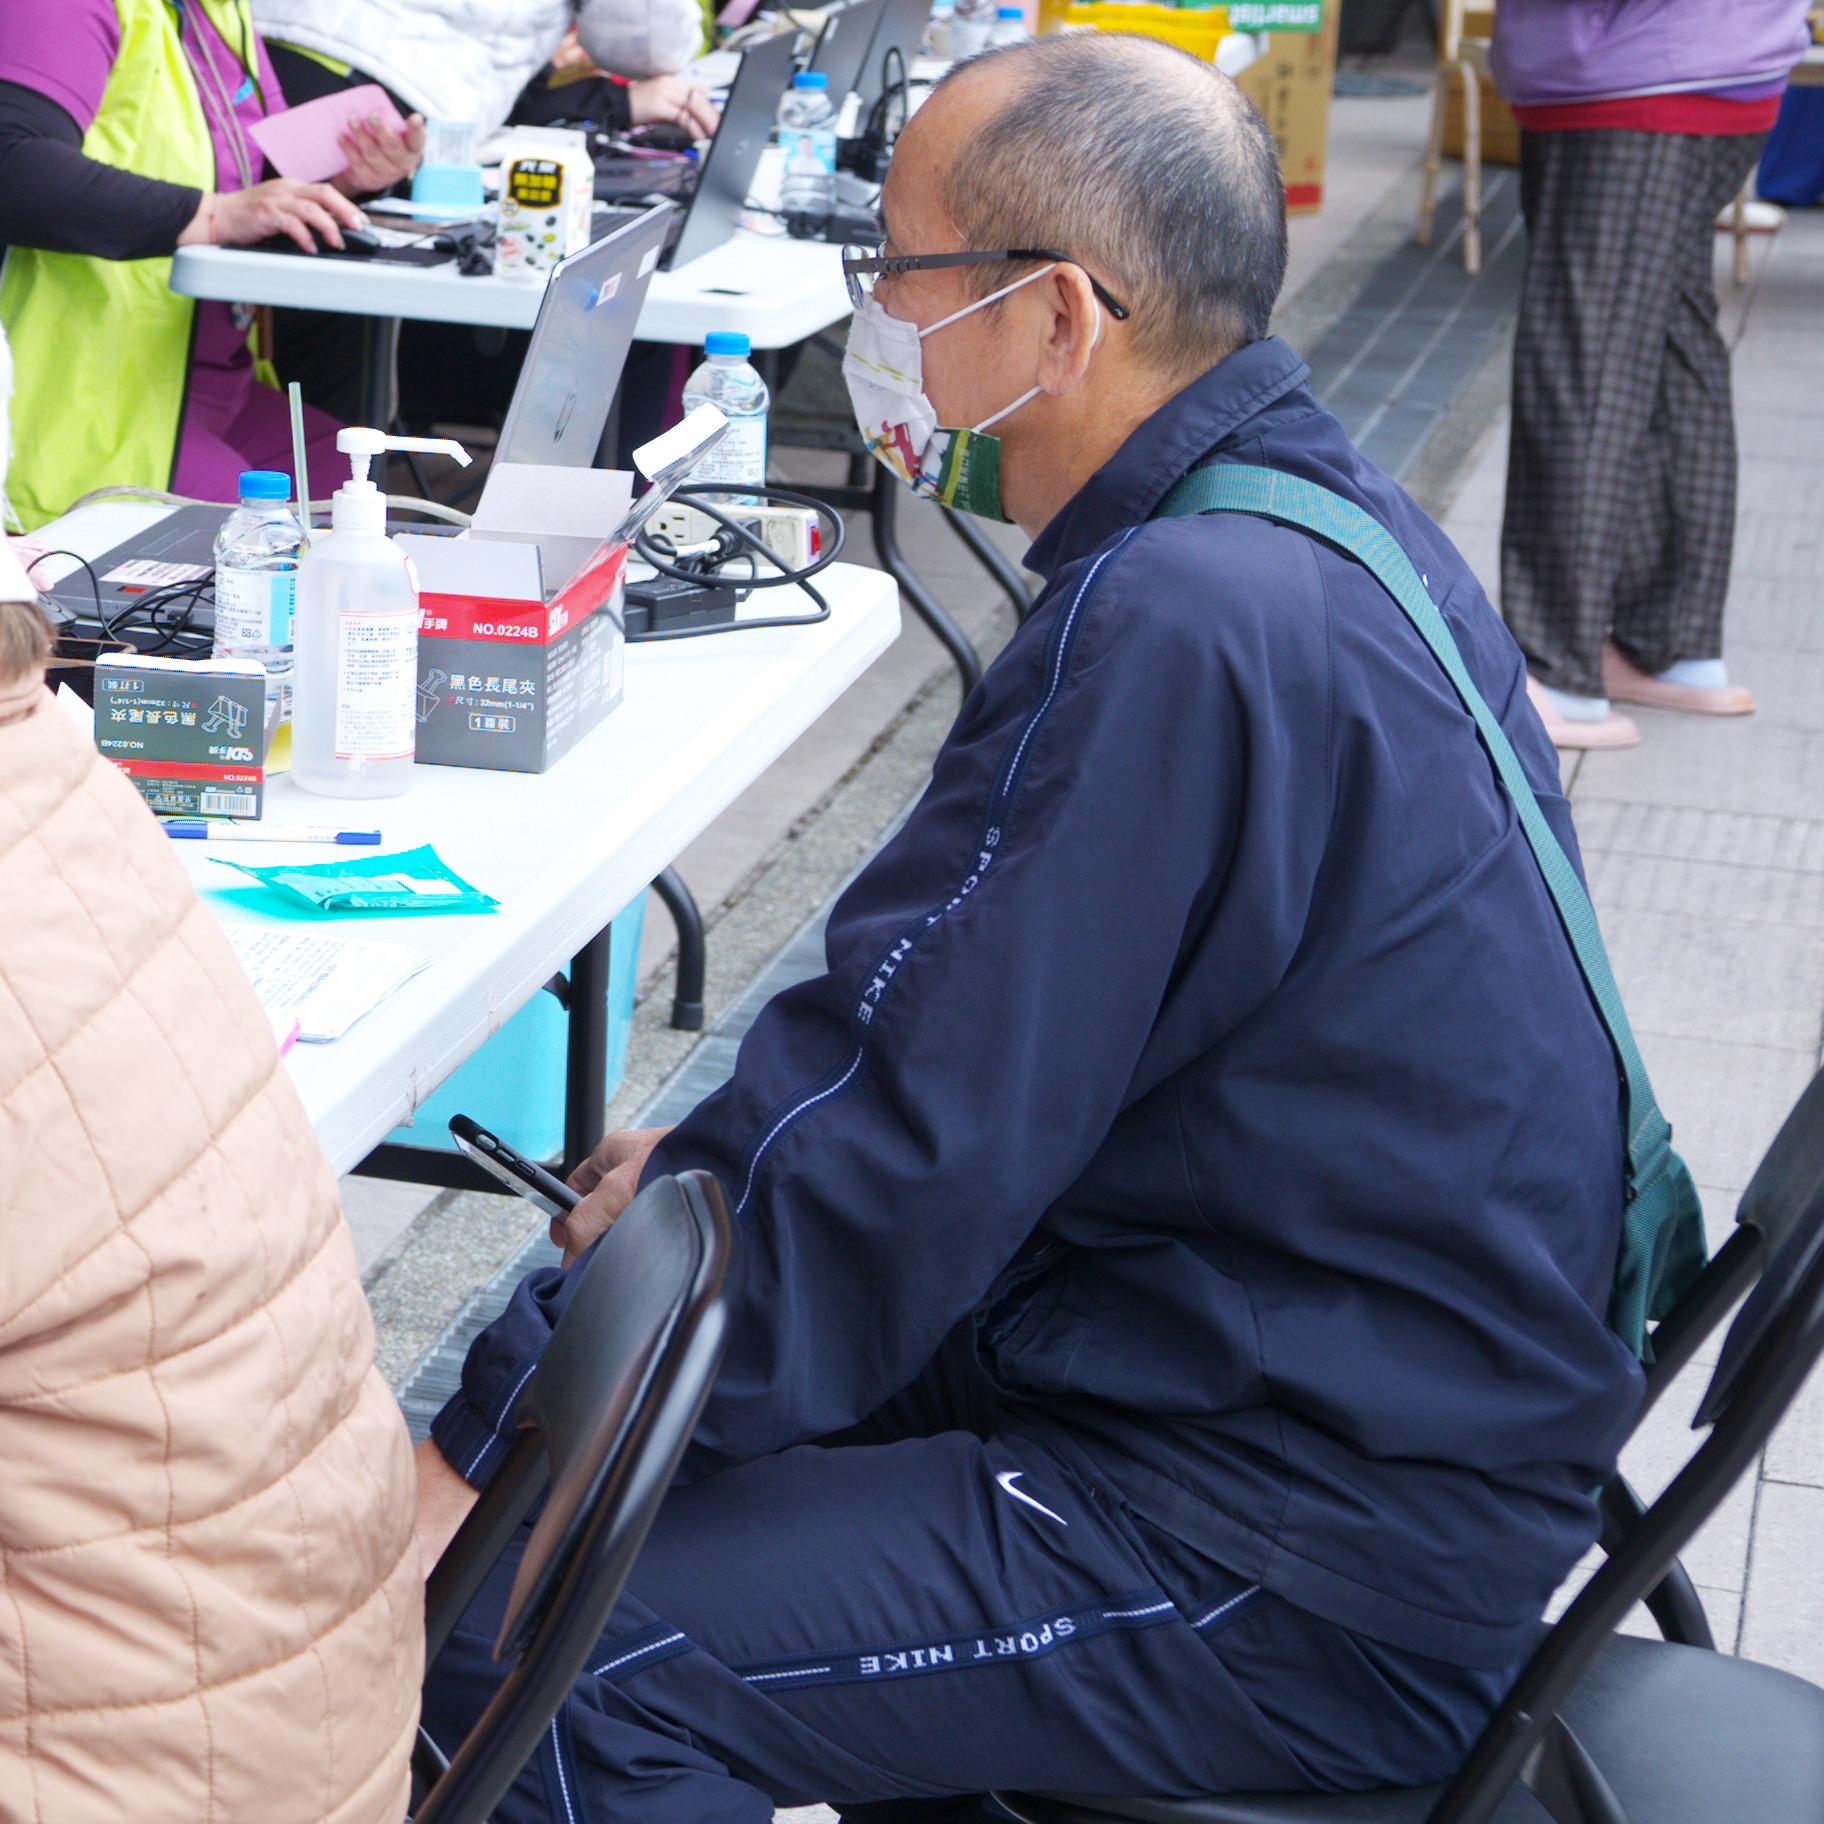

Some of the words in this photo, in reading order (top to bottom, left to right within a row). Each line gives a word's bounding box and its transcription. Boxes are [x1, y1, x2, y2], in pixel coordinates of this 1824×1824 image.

[473, 623, 539, 638] NO.0224B
[450, 674, 536, 696] 黑色長尾夾
[110, 708, 197, 726] 黑色長尾夾
[857, 938, 913, 1025] NIKE
[974, 1616, 1077, 1659] SPORT
[859, 1644, 954, 1674] NIKE
